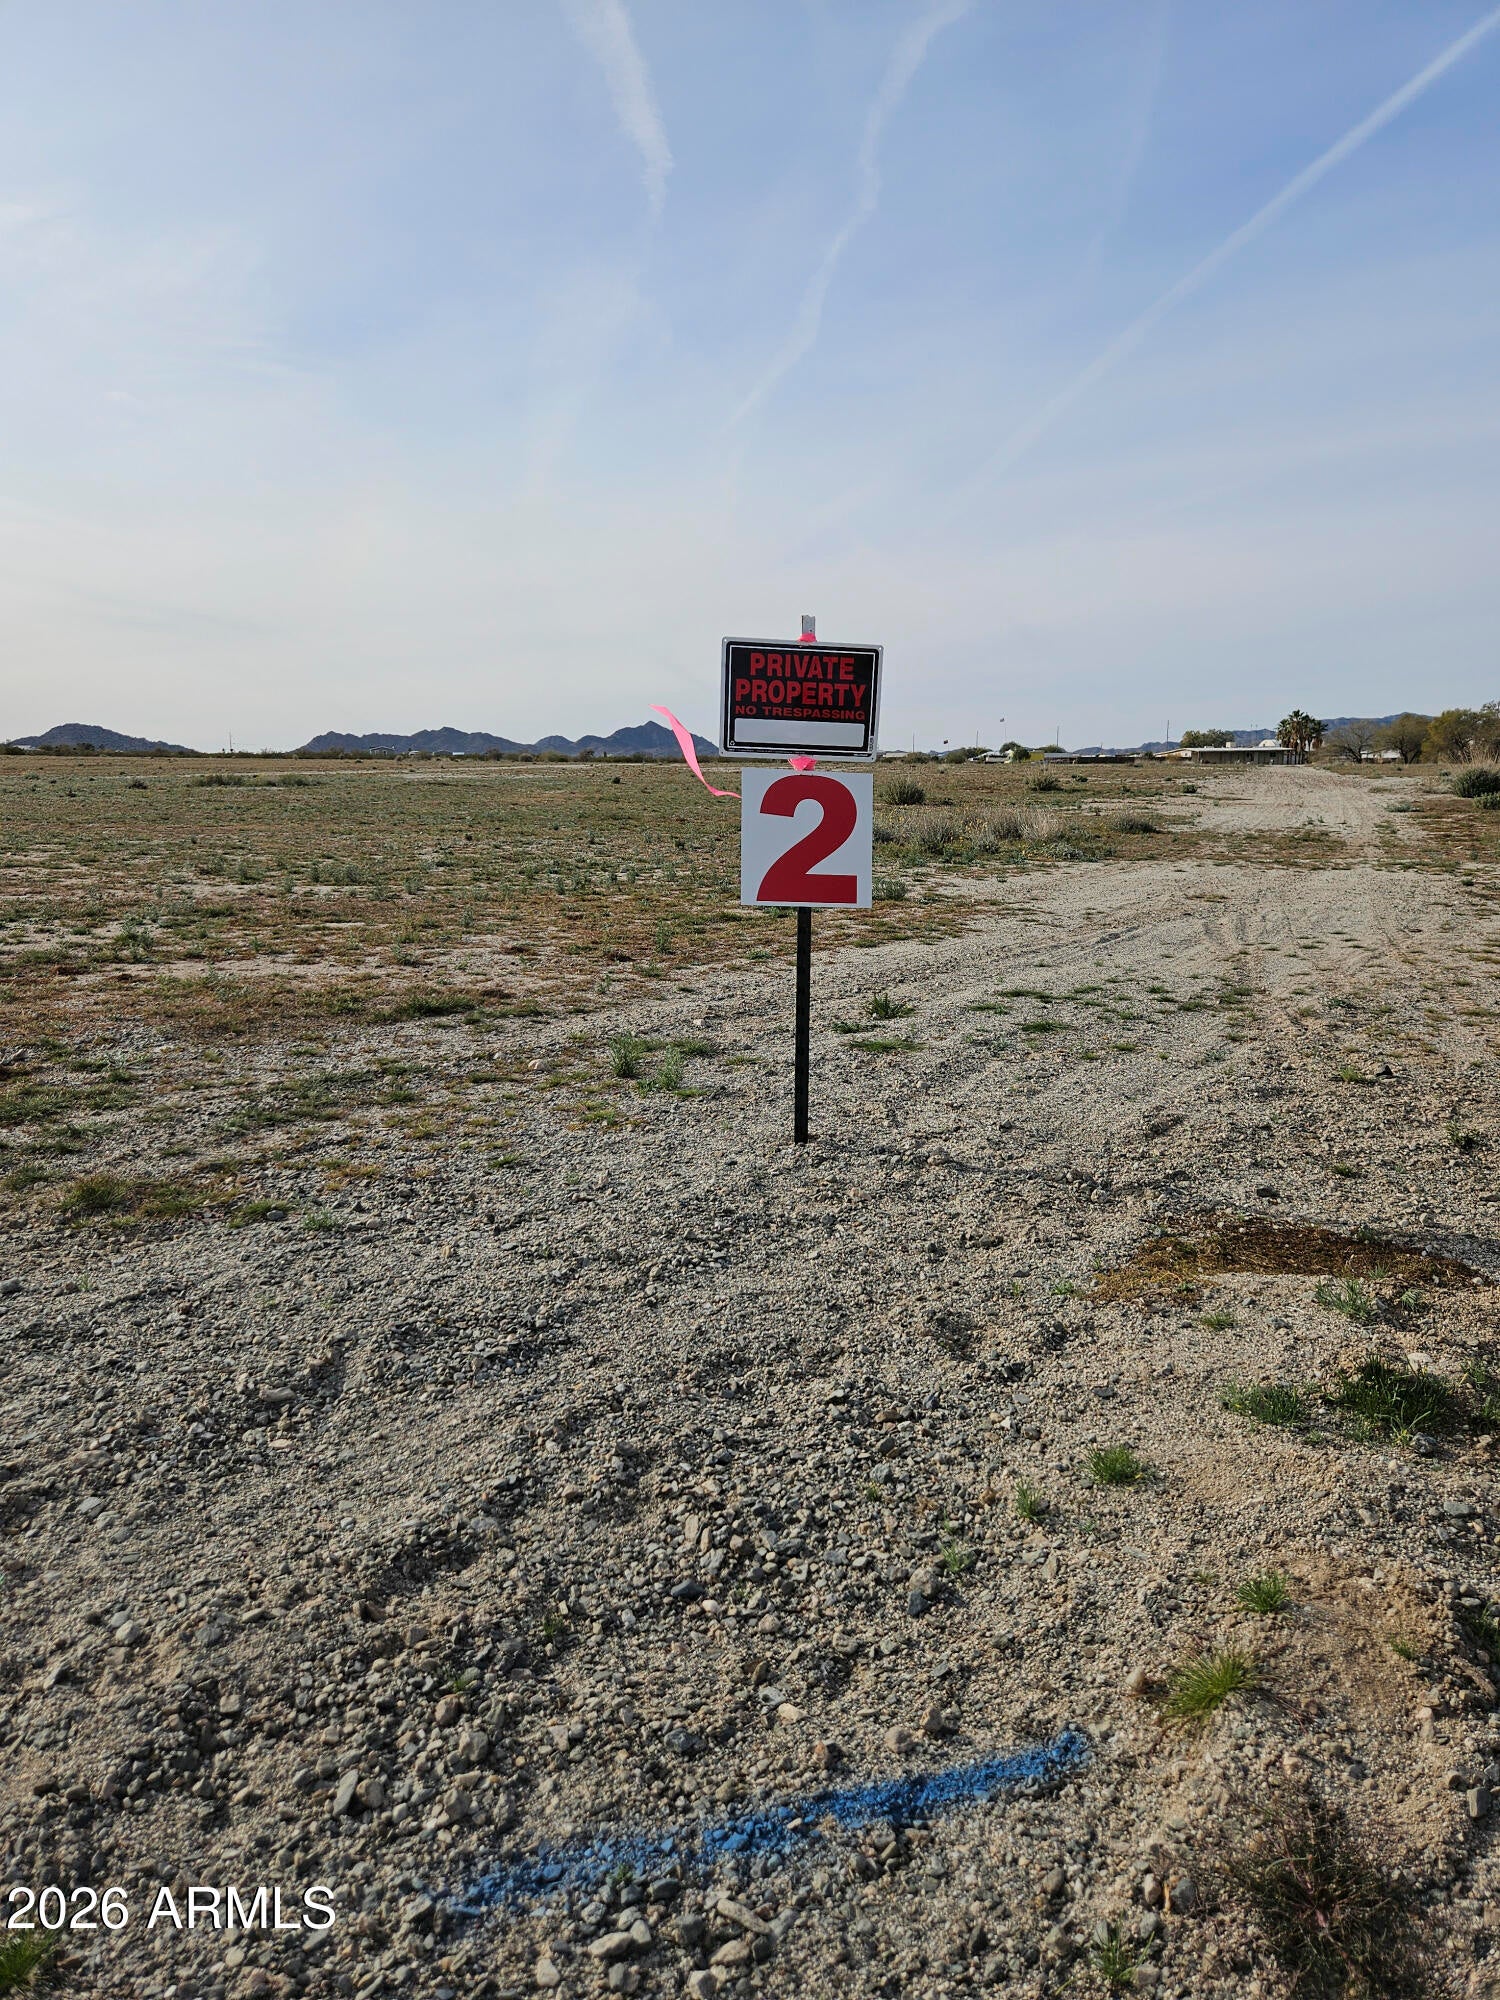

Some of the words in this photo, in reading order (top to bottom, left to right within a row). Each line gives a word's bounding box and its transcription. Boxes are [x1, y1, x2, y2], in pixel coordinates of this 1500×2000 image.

[750, 652, 855, 681] PRIVATE
[735, 678, 866, 707] PROPERTY
[735, 705, 757, 716] NO
[763, 706, 866, 721] TRESPASSING
[756, 774, 857, 904] 2
